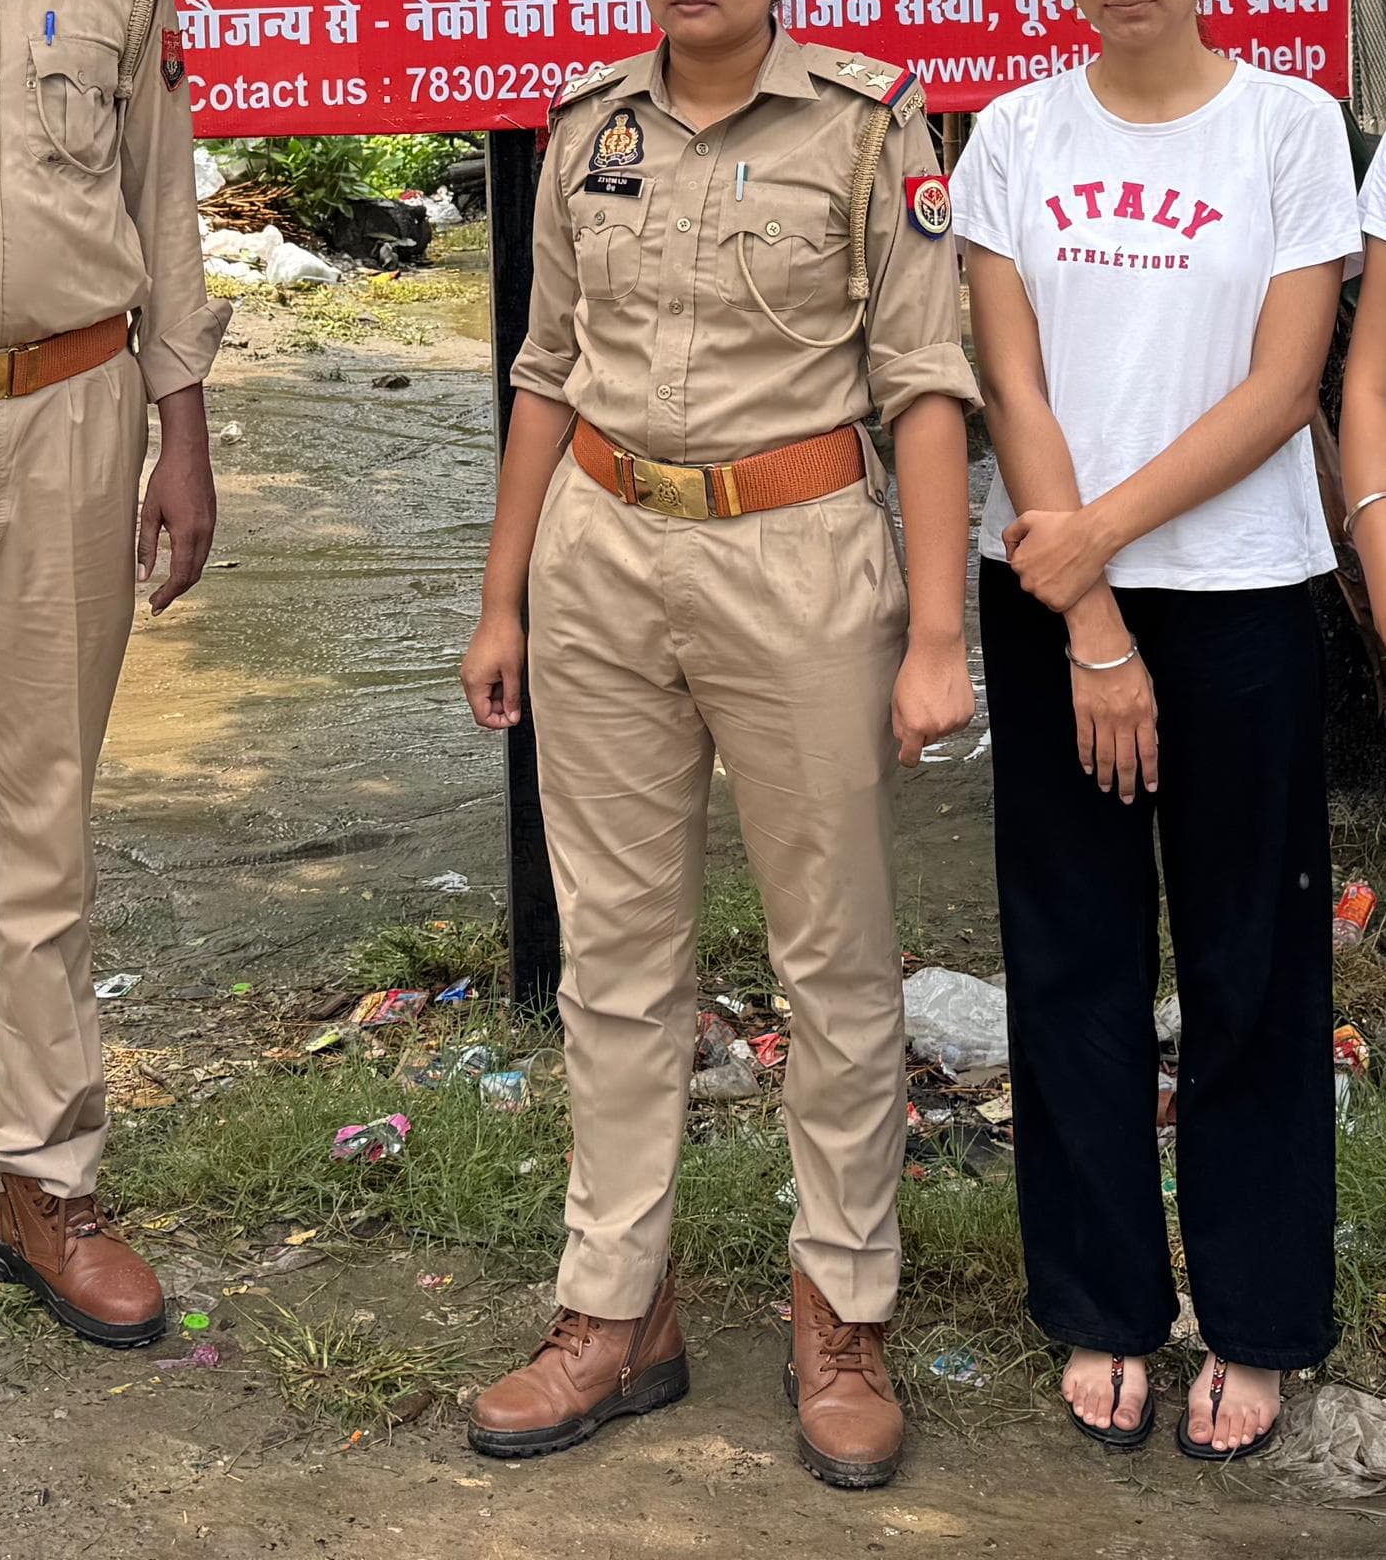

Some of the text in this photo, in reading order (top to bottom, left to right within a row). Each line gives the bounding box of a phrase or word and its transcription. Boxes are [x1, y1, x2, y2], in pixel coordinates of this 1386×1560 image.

[187, 72, 309, 113] Cotact
[321, 77, 367, 106] us
[1045, 181, 1223, 240] ITALY
[1057, 245, 1190, 270] ATHLÉTIQUE
